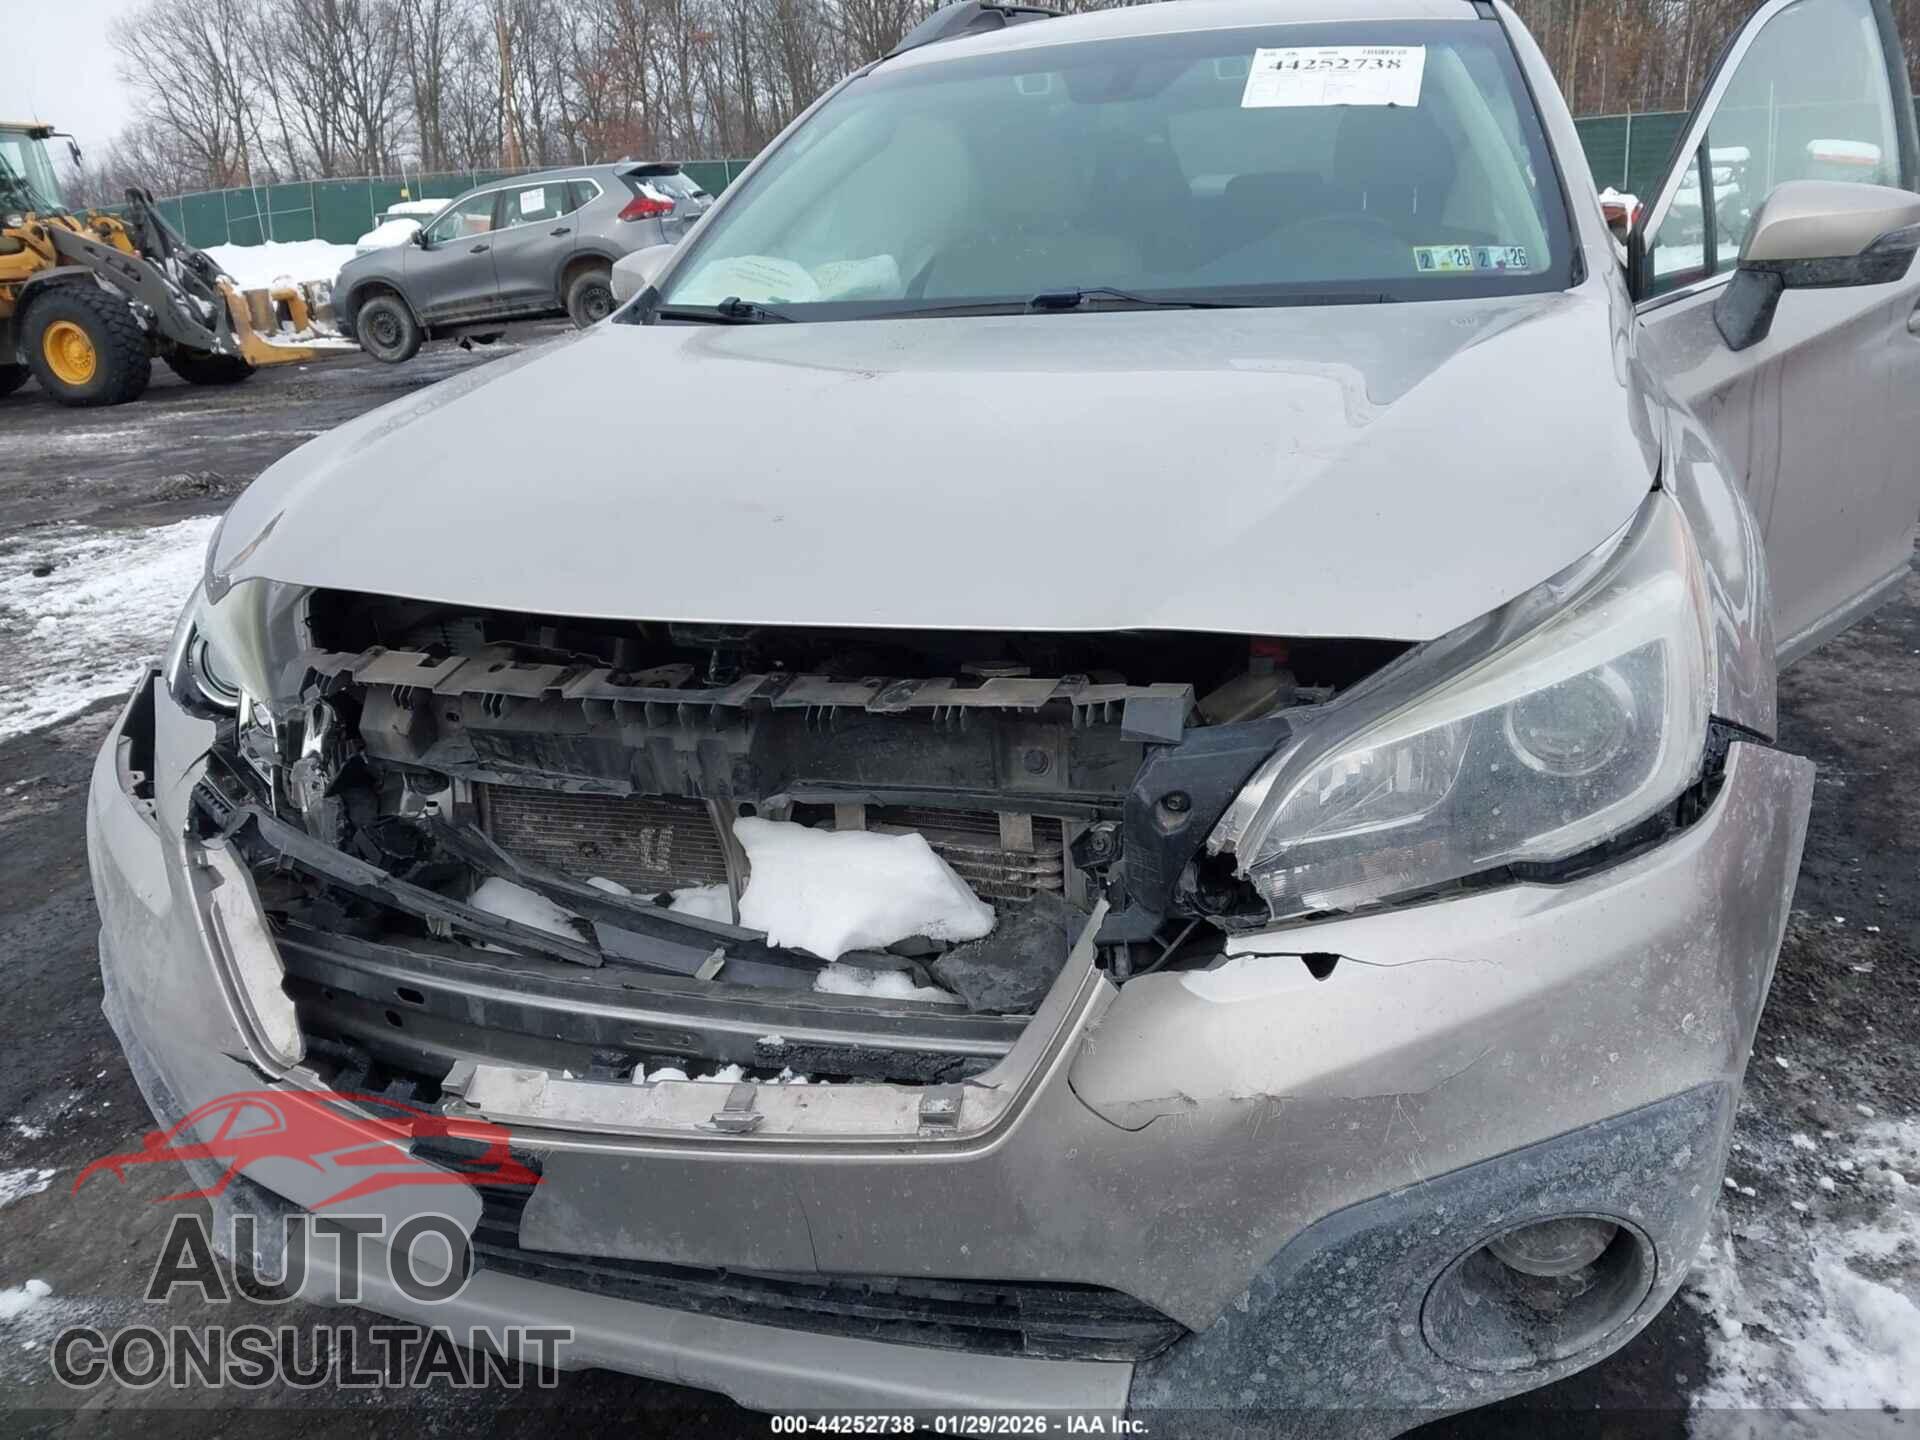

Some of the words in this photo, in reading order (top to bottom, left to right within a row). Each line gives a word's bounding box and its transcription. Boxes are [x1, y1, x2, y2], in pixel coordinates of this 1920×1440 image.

[1268, 57, 1402, 71] 44252738
[1421, 253, 1433, 269] 2
[1454, 248, 1471, 266] 26
[1478, 252, 1489, 268] 2
[1510, 248, 1527, 266] 26
